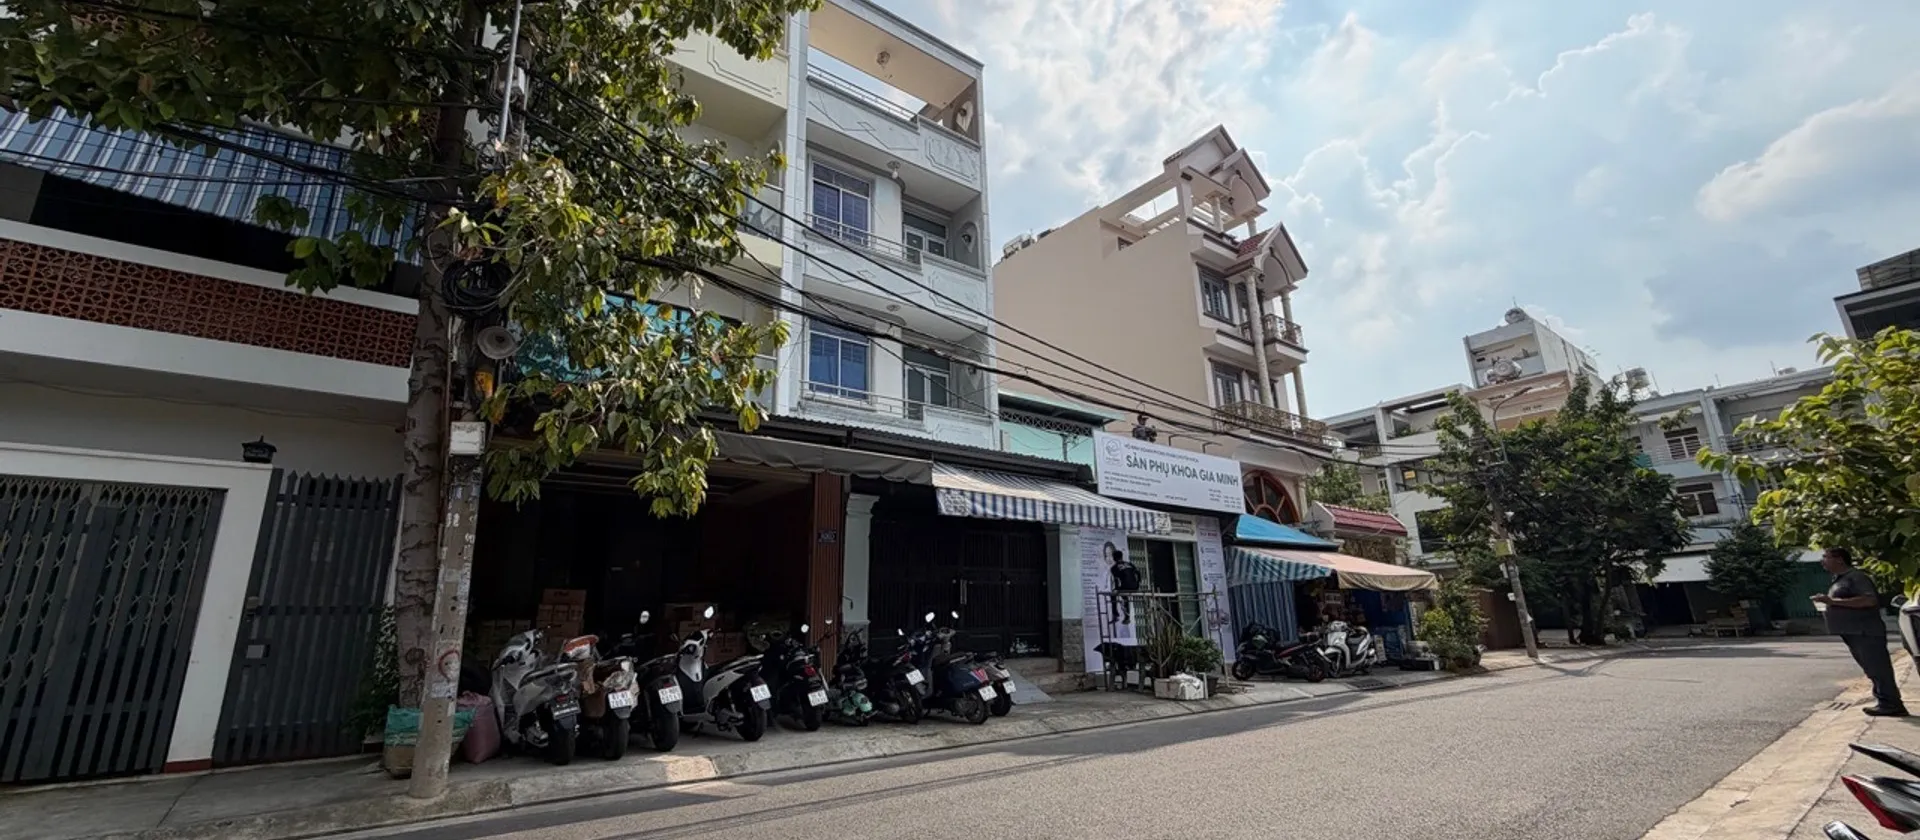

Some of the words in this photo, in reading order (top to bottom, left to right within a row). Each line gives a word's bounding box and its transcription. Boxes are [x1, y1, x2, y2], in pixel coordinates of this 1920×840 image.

[1126, 452, 1147, 471] SẢN
[1150, 460, 1170, 478] PHỤ
[1172, 463, 1198, 480] KHOA
[1199, 469, 1215, 482] GIA
[1217, 472, 1239, 487] MINH
